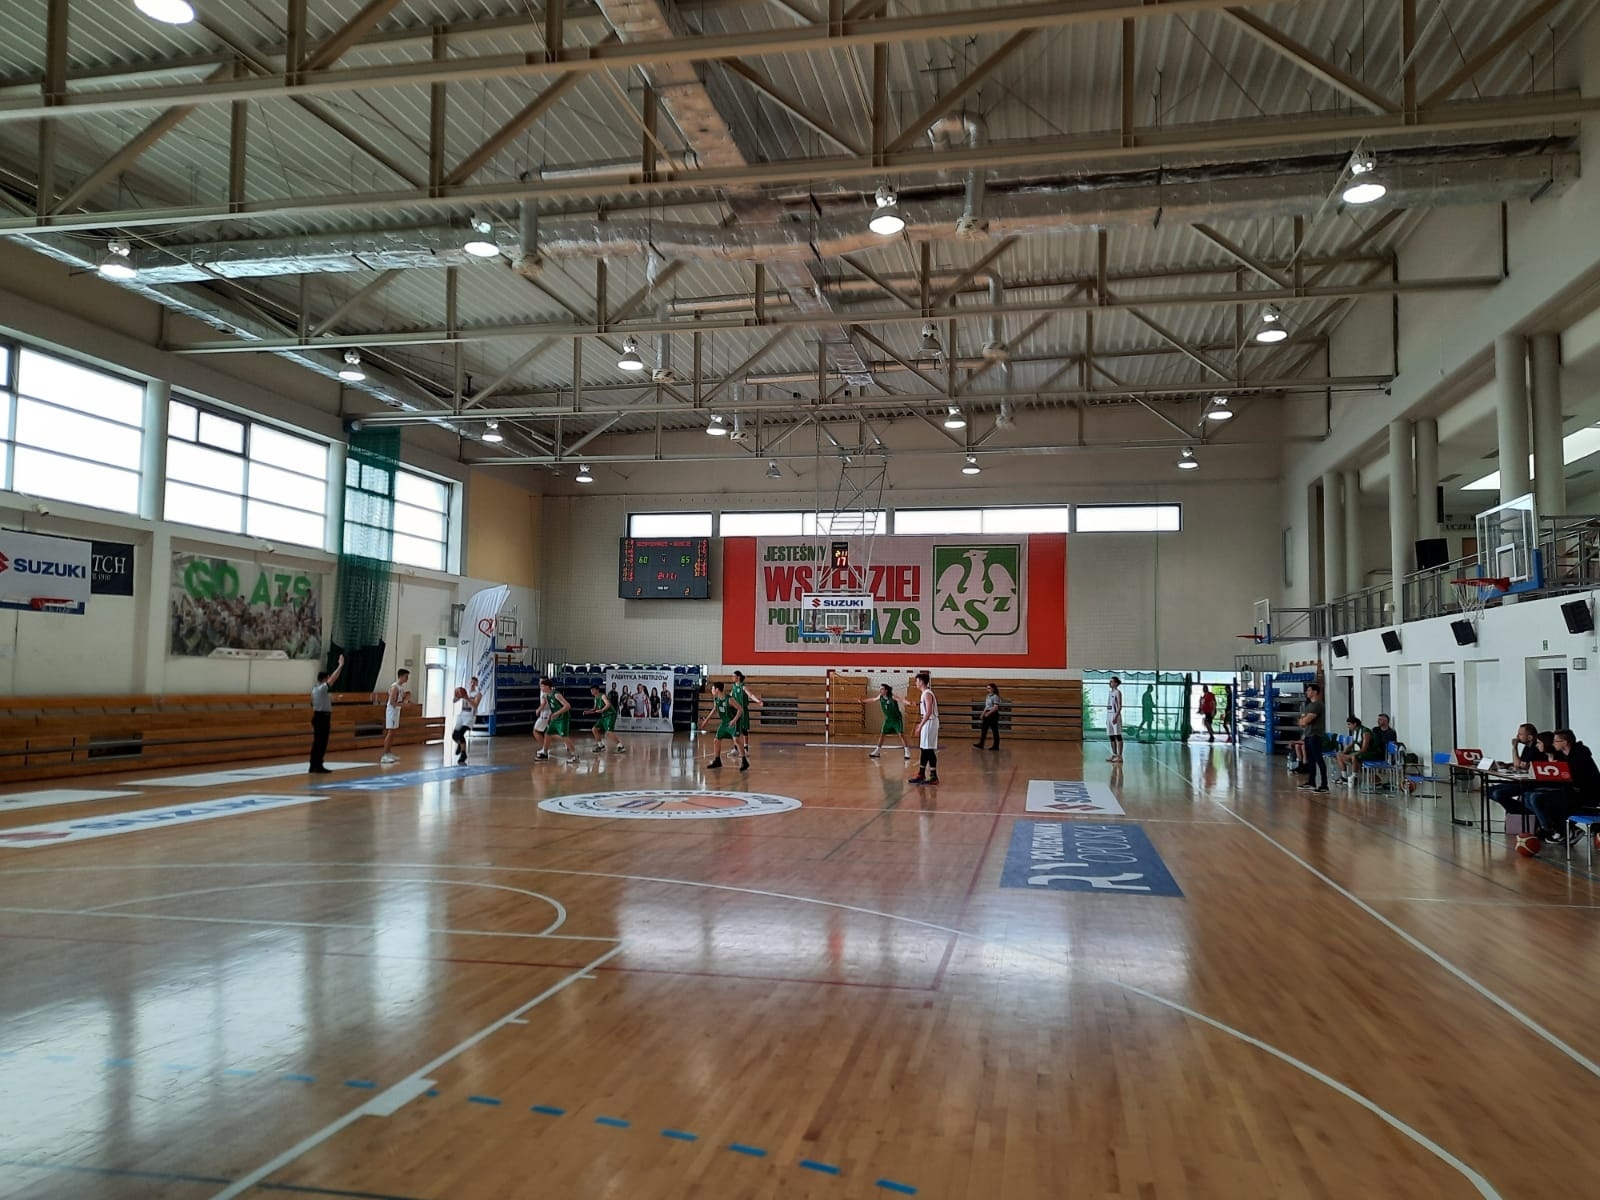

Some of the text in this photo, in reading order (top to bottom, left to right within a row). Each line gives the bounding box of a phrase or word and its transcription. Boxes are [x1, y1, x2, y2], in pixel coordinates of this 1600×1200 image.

[13, 558, 86, 579] SUZUKI
[836, 556, 847, 567] 17
[250, 571, 312, 608] AZS
[1053, 781, 1092, 803] SUZUKI
[1029, 823, 1065, 861] POLITECHNIKA
[1073, 825, 1138, 863] OPOLSKA
